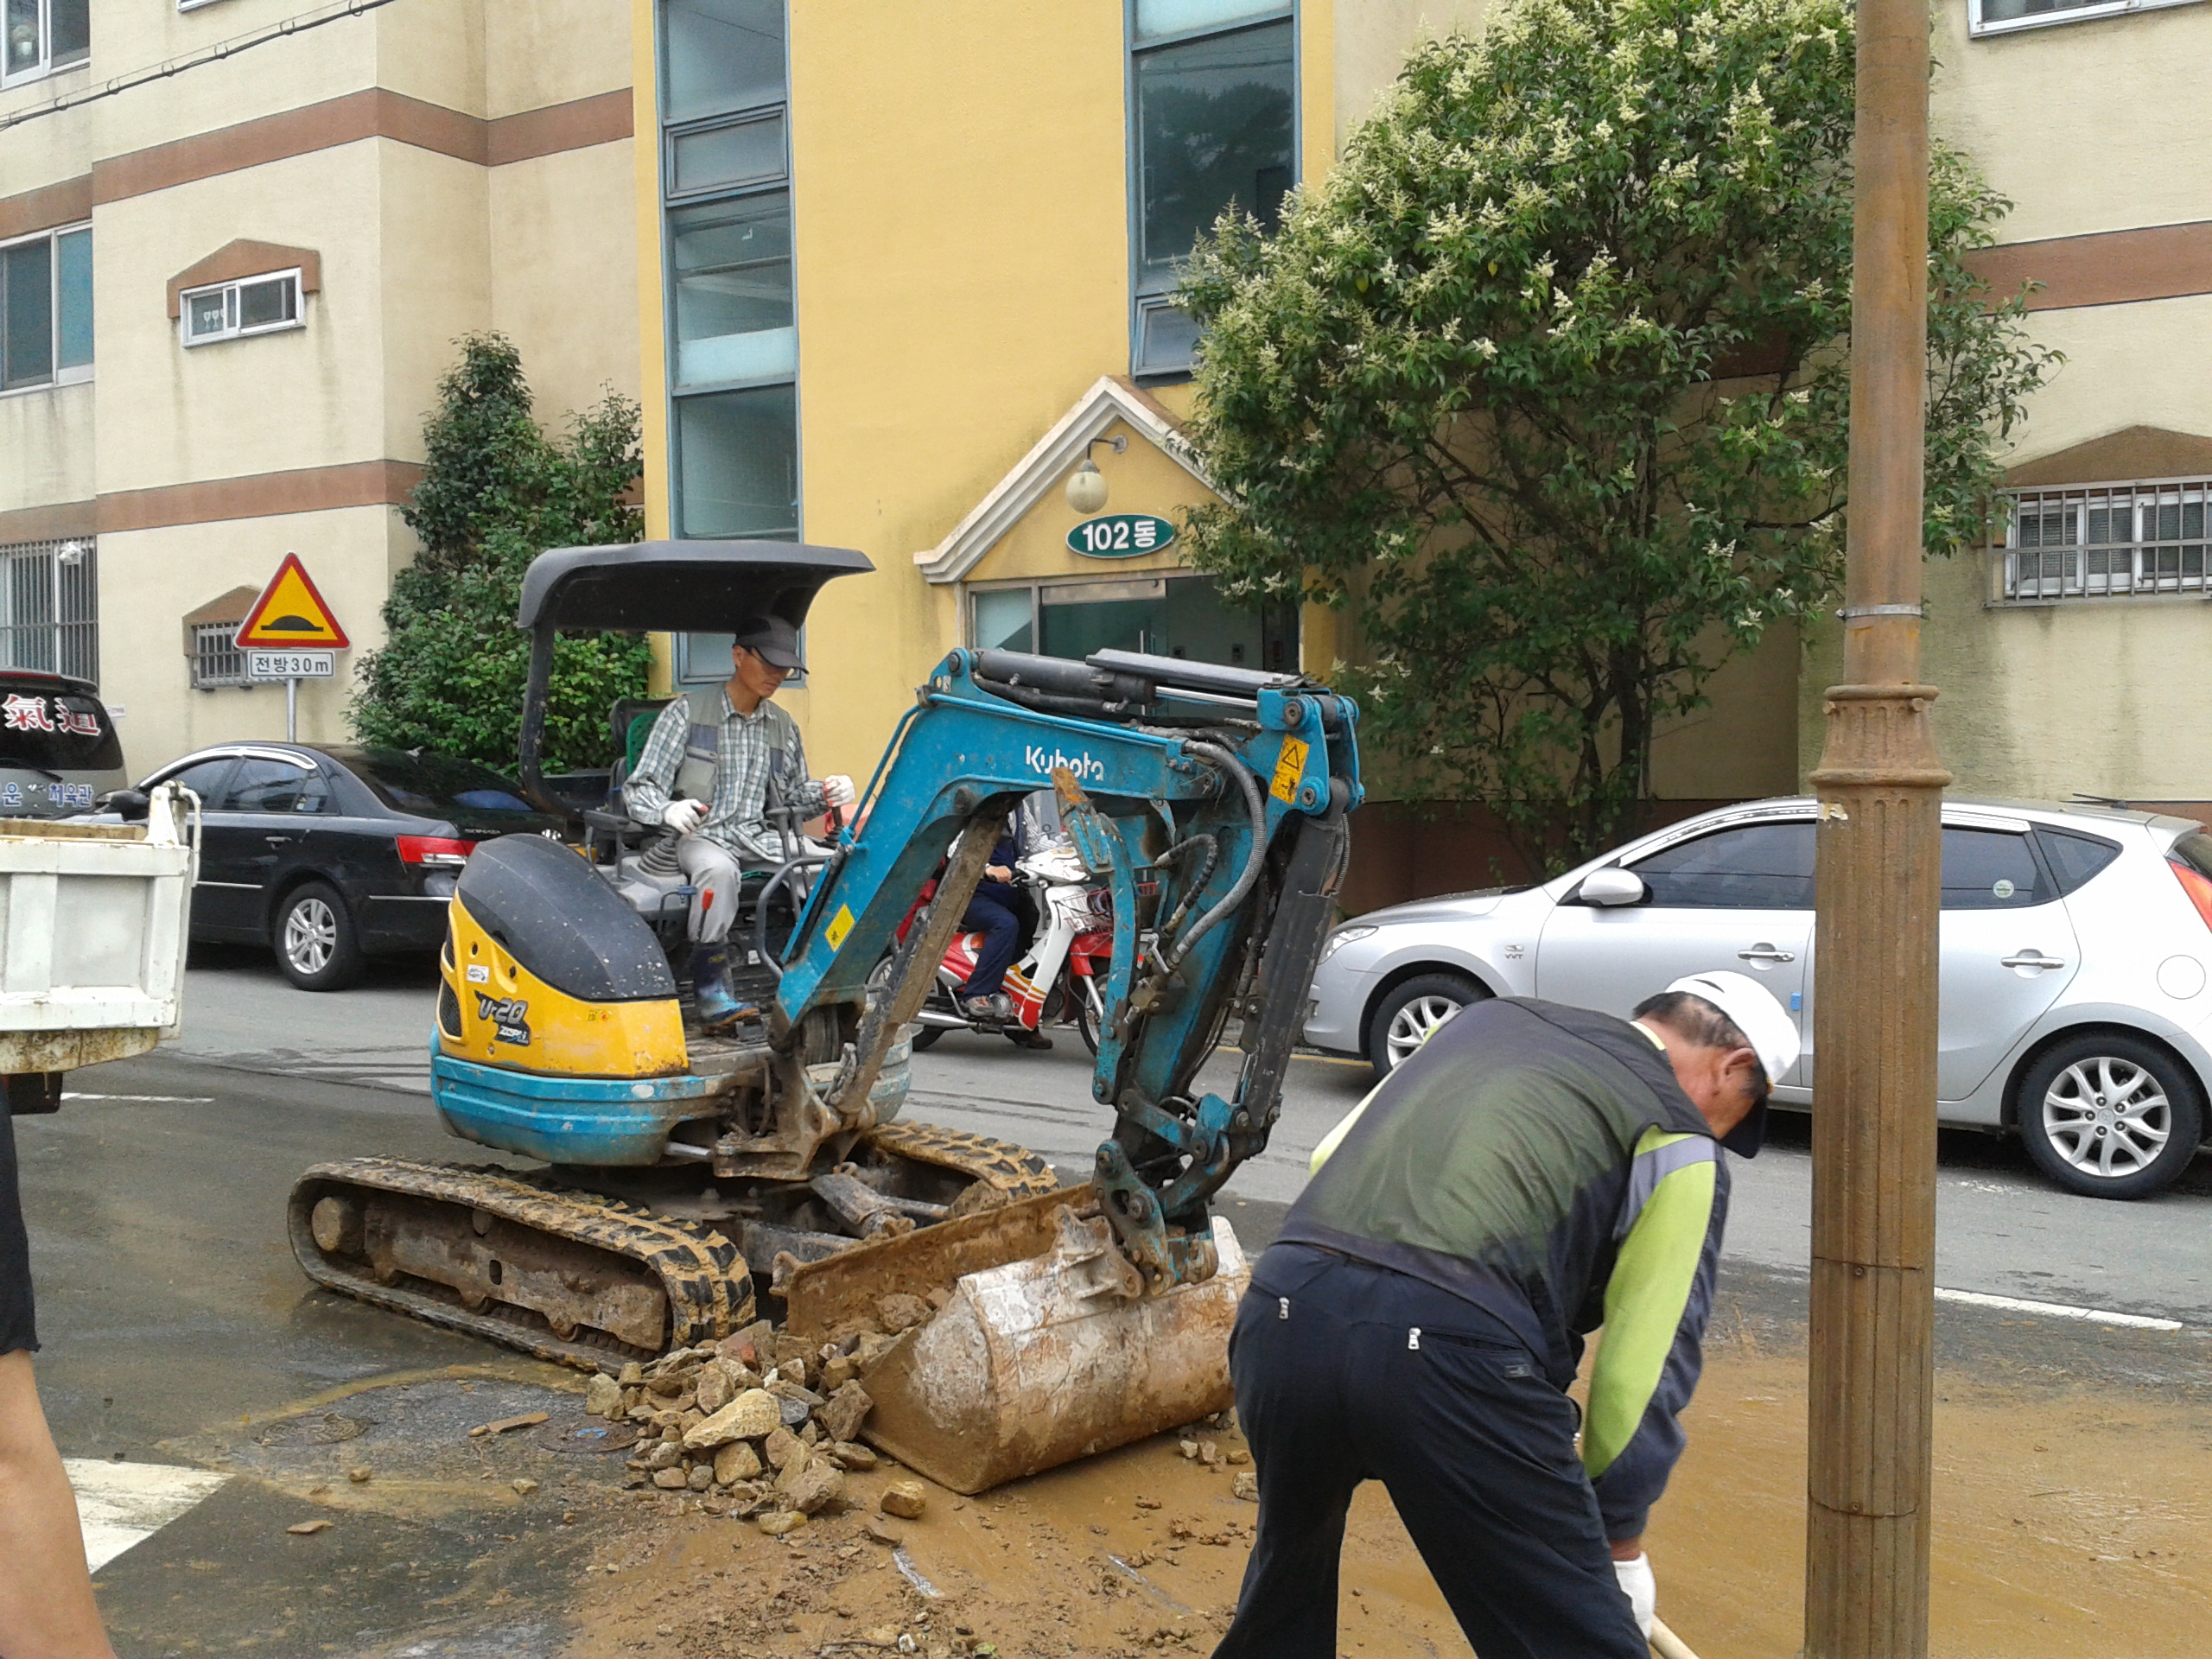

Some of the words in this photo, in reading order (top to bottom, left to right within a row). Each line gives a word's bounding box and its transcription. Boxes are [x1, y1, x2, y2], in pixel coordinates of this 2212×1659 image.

[1082, 520, 1156, 551] 102동
[1025, 744, 1104, 781] Kubota
[479, 996, 528, 1025] U-20
